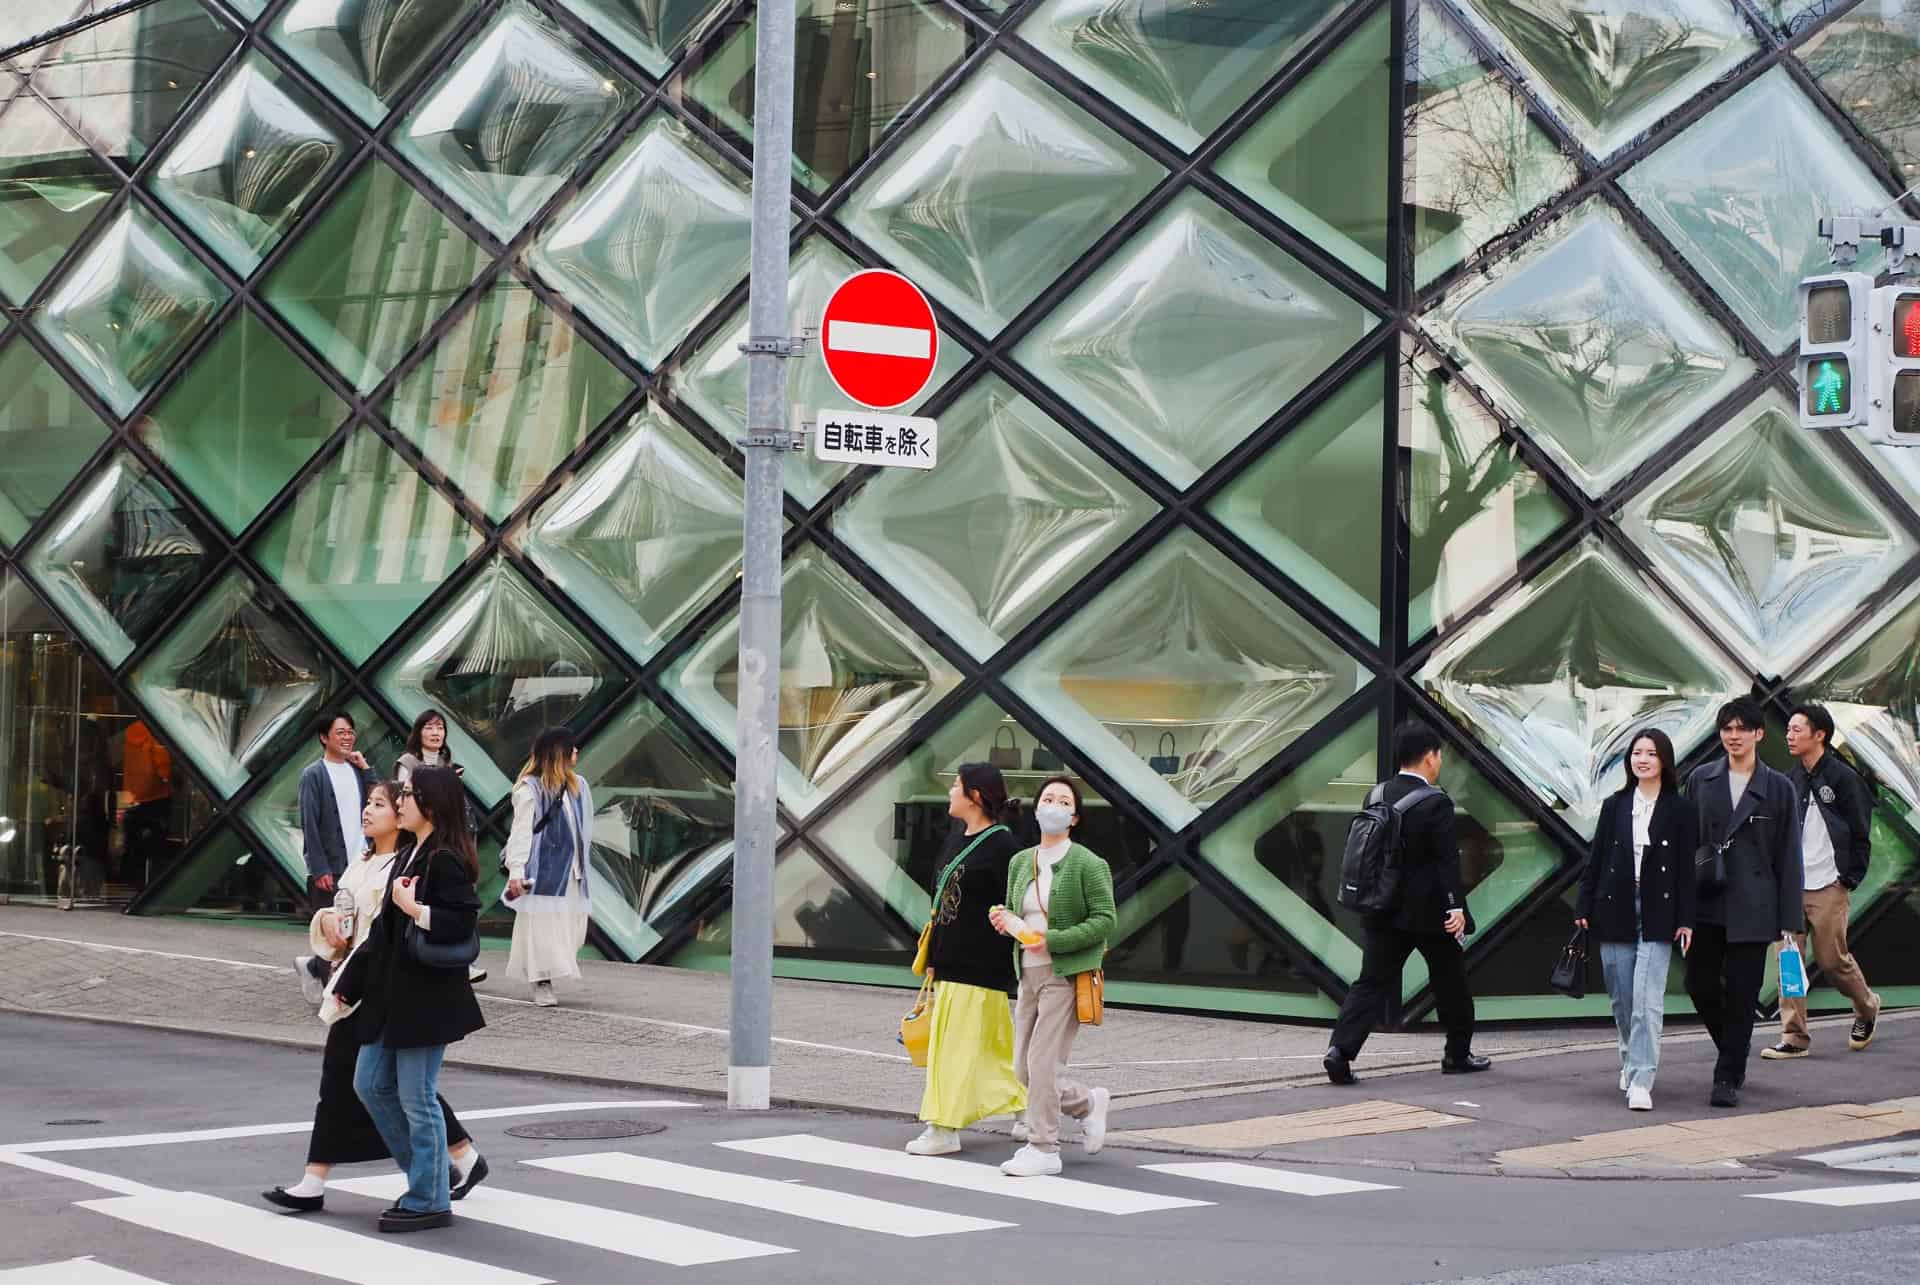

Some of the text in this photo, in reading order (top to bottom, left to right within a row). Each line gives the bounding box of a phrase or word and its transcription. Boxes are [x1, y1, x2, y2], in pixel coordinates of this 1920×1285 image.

[824, 421, 930, 457] 自転車を除く
